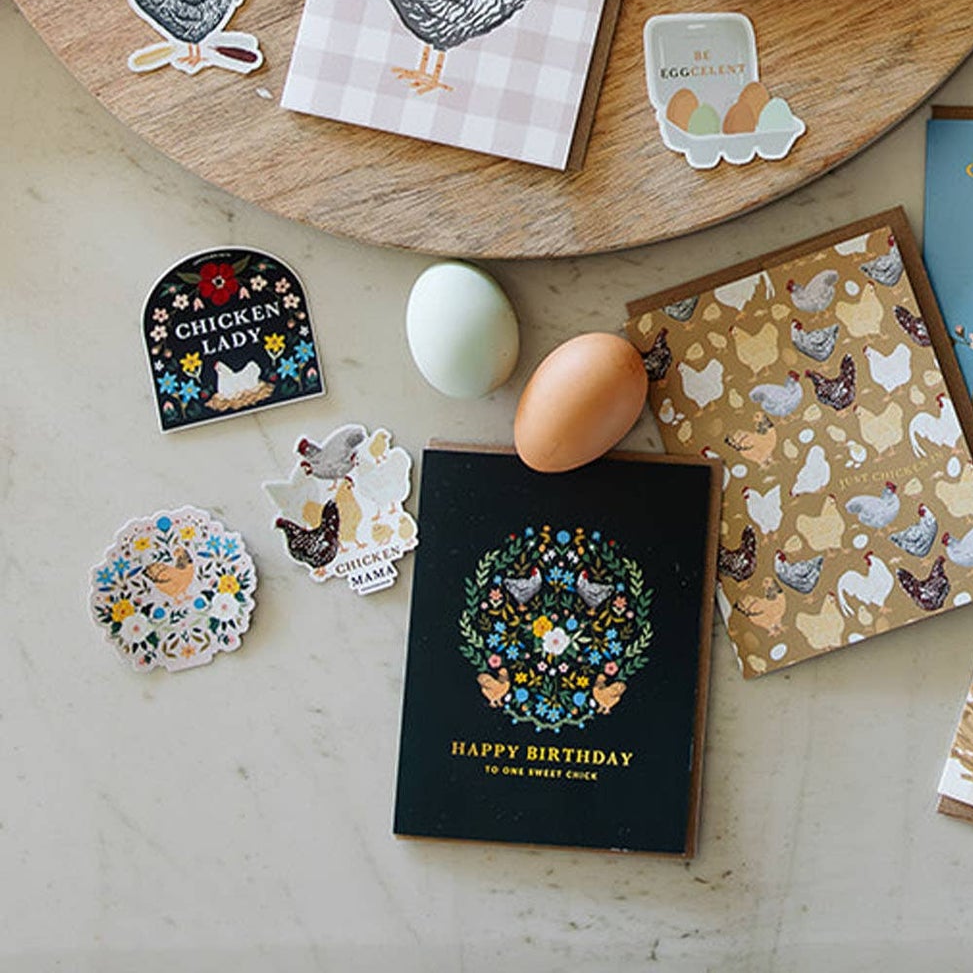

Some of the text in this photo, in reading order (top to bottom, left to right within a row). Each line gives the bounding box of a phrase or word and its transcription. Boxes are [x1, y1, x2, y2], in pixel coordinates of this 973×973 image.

[175, 301, 280, 339] CHICKEN
[202, 327, 260, 355] LADY
[335, 545, 400, 574] CHICKEN
[351, 565, 394, 587] MAMA
[451, 741, 634, 767] HAPPY BIRTHDAY
[484, 765, 598, 781] TO ONE SWEET CHICK
